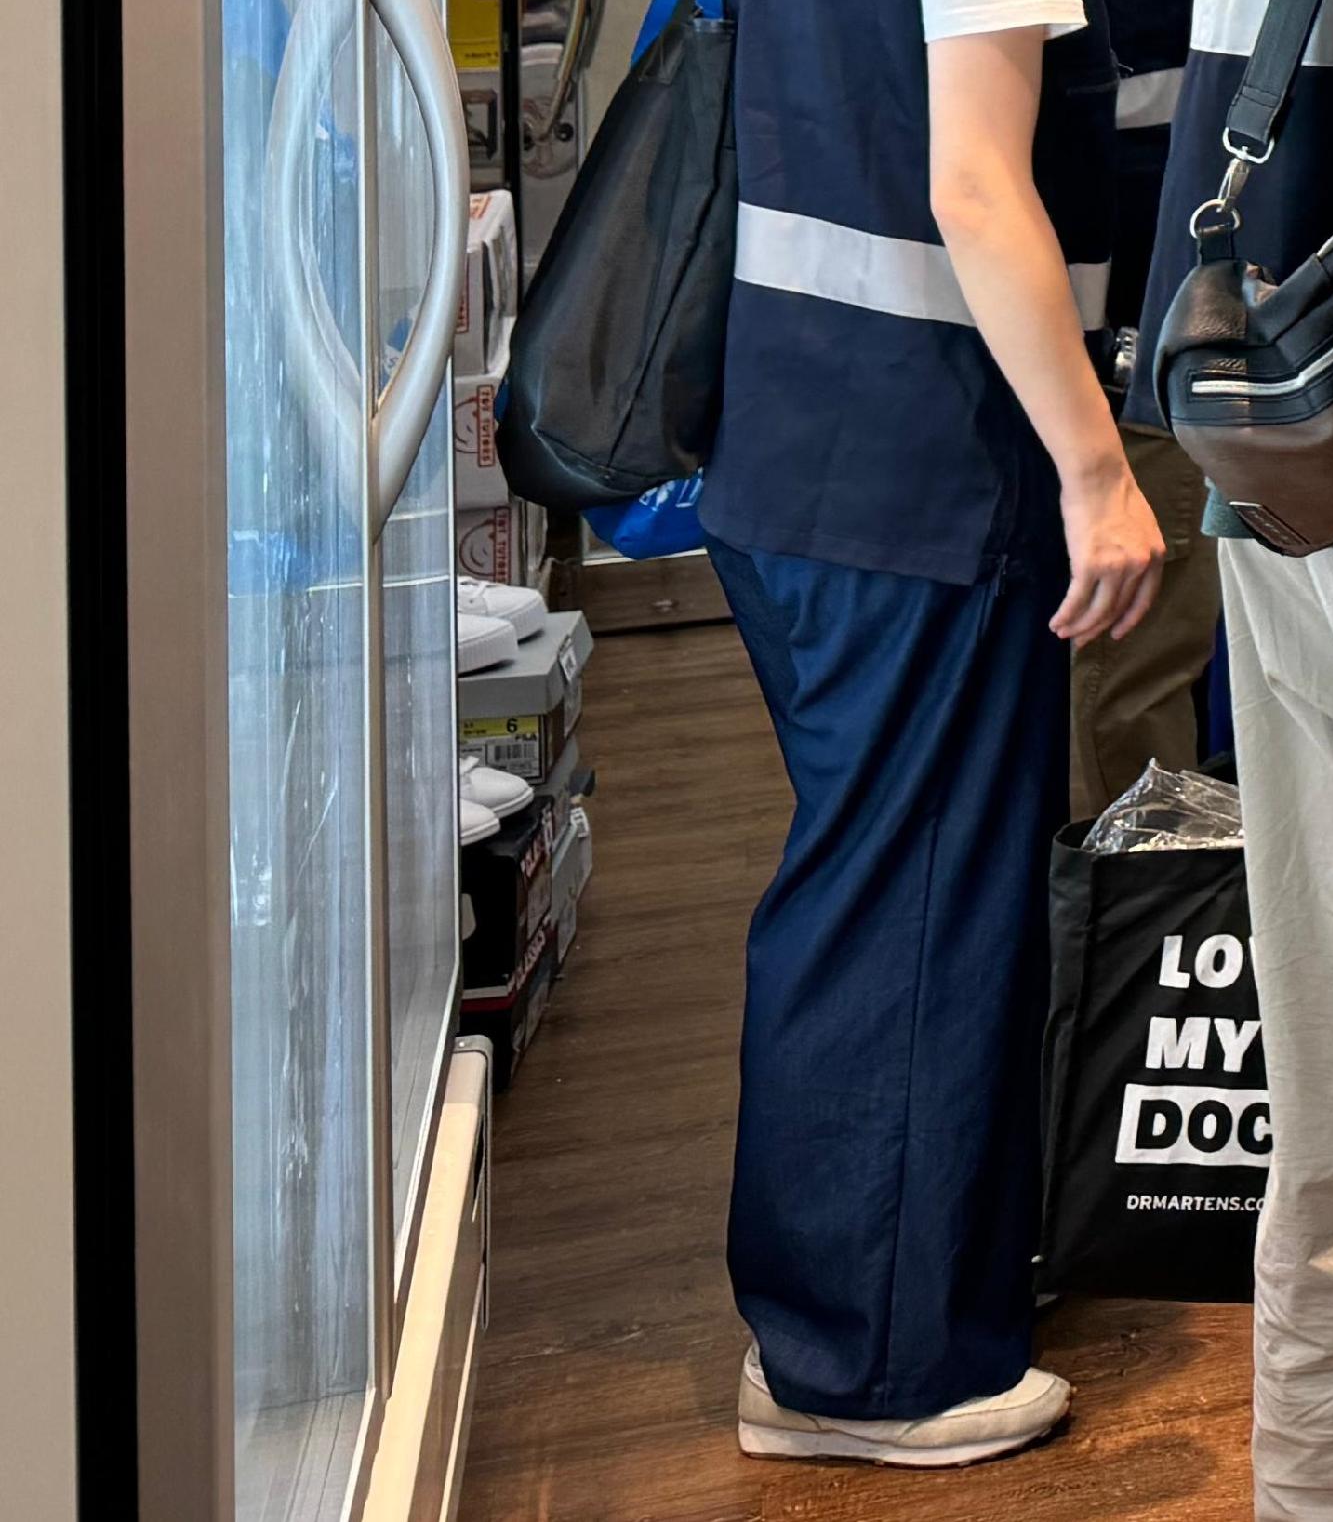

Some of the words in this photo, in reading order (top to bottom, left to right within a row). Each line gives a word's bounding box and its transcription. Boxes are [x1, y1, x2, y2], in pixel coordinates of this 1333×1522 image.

[506, 718, 518, 732] 6
[1159, 934, 1256, 988] LO
[1145, 1016, 1262, 1073] MY
